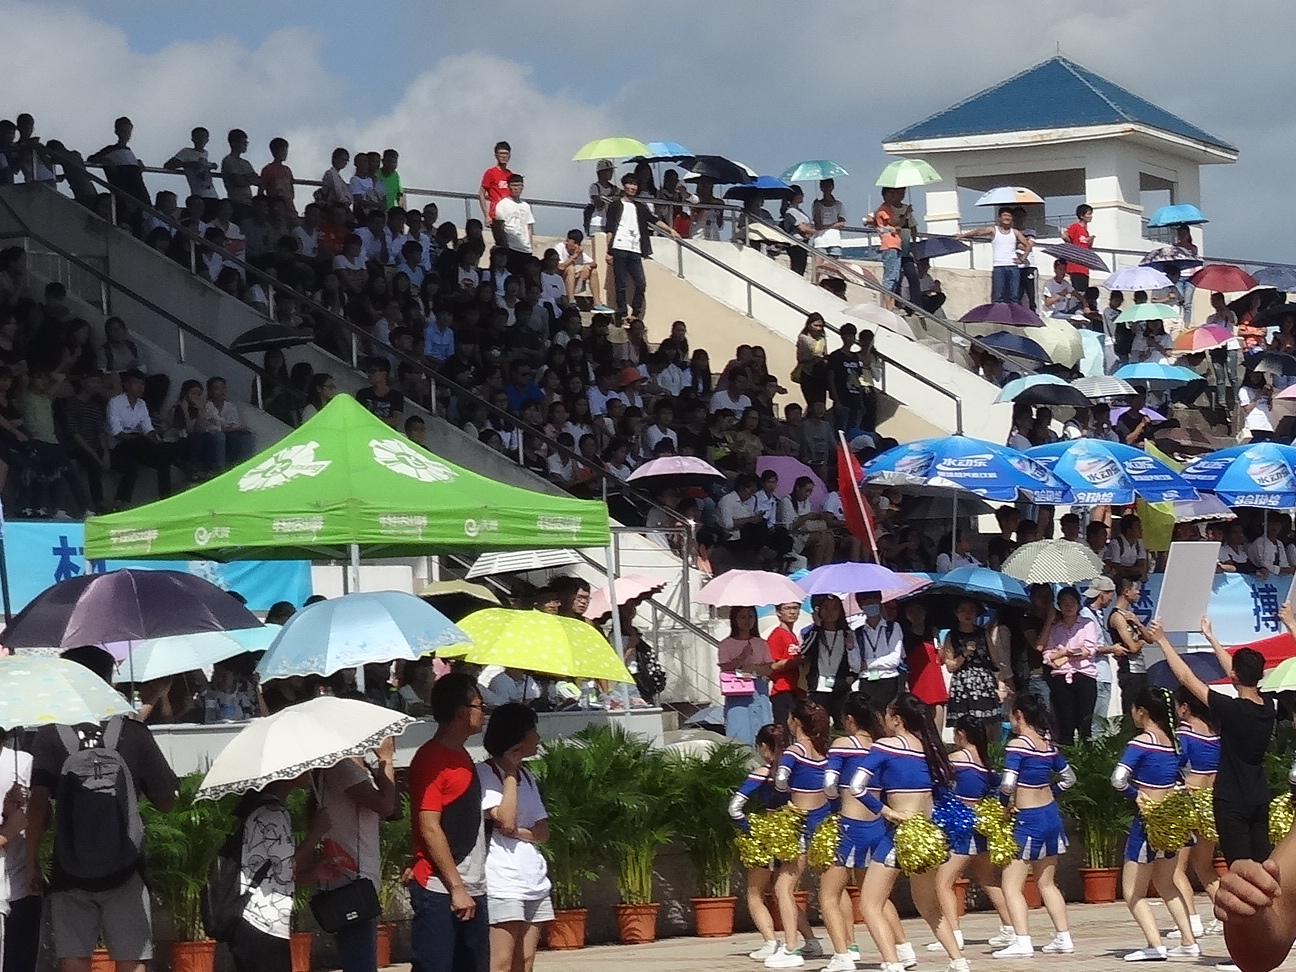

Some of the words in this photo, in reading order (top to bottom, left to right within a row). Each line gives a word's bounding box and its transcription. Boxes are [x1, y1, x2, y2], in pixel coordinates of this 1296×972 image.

[942, 458, 988, 467] 水动乐
[1087, 464, 1120, 481] 水动乐
[1257, 468, 1290, 484] 水动乐
